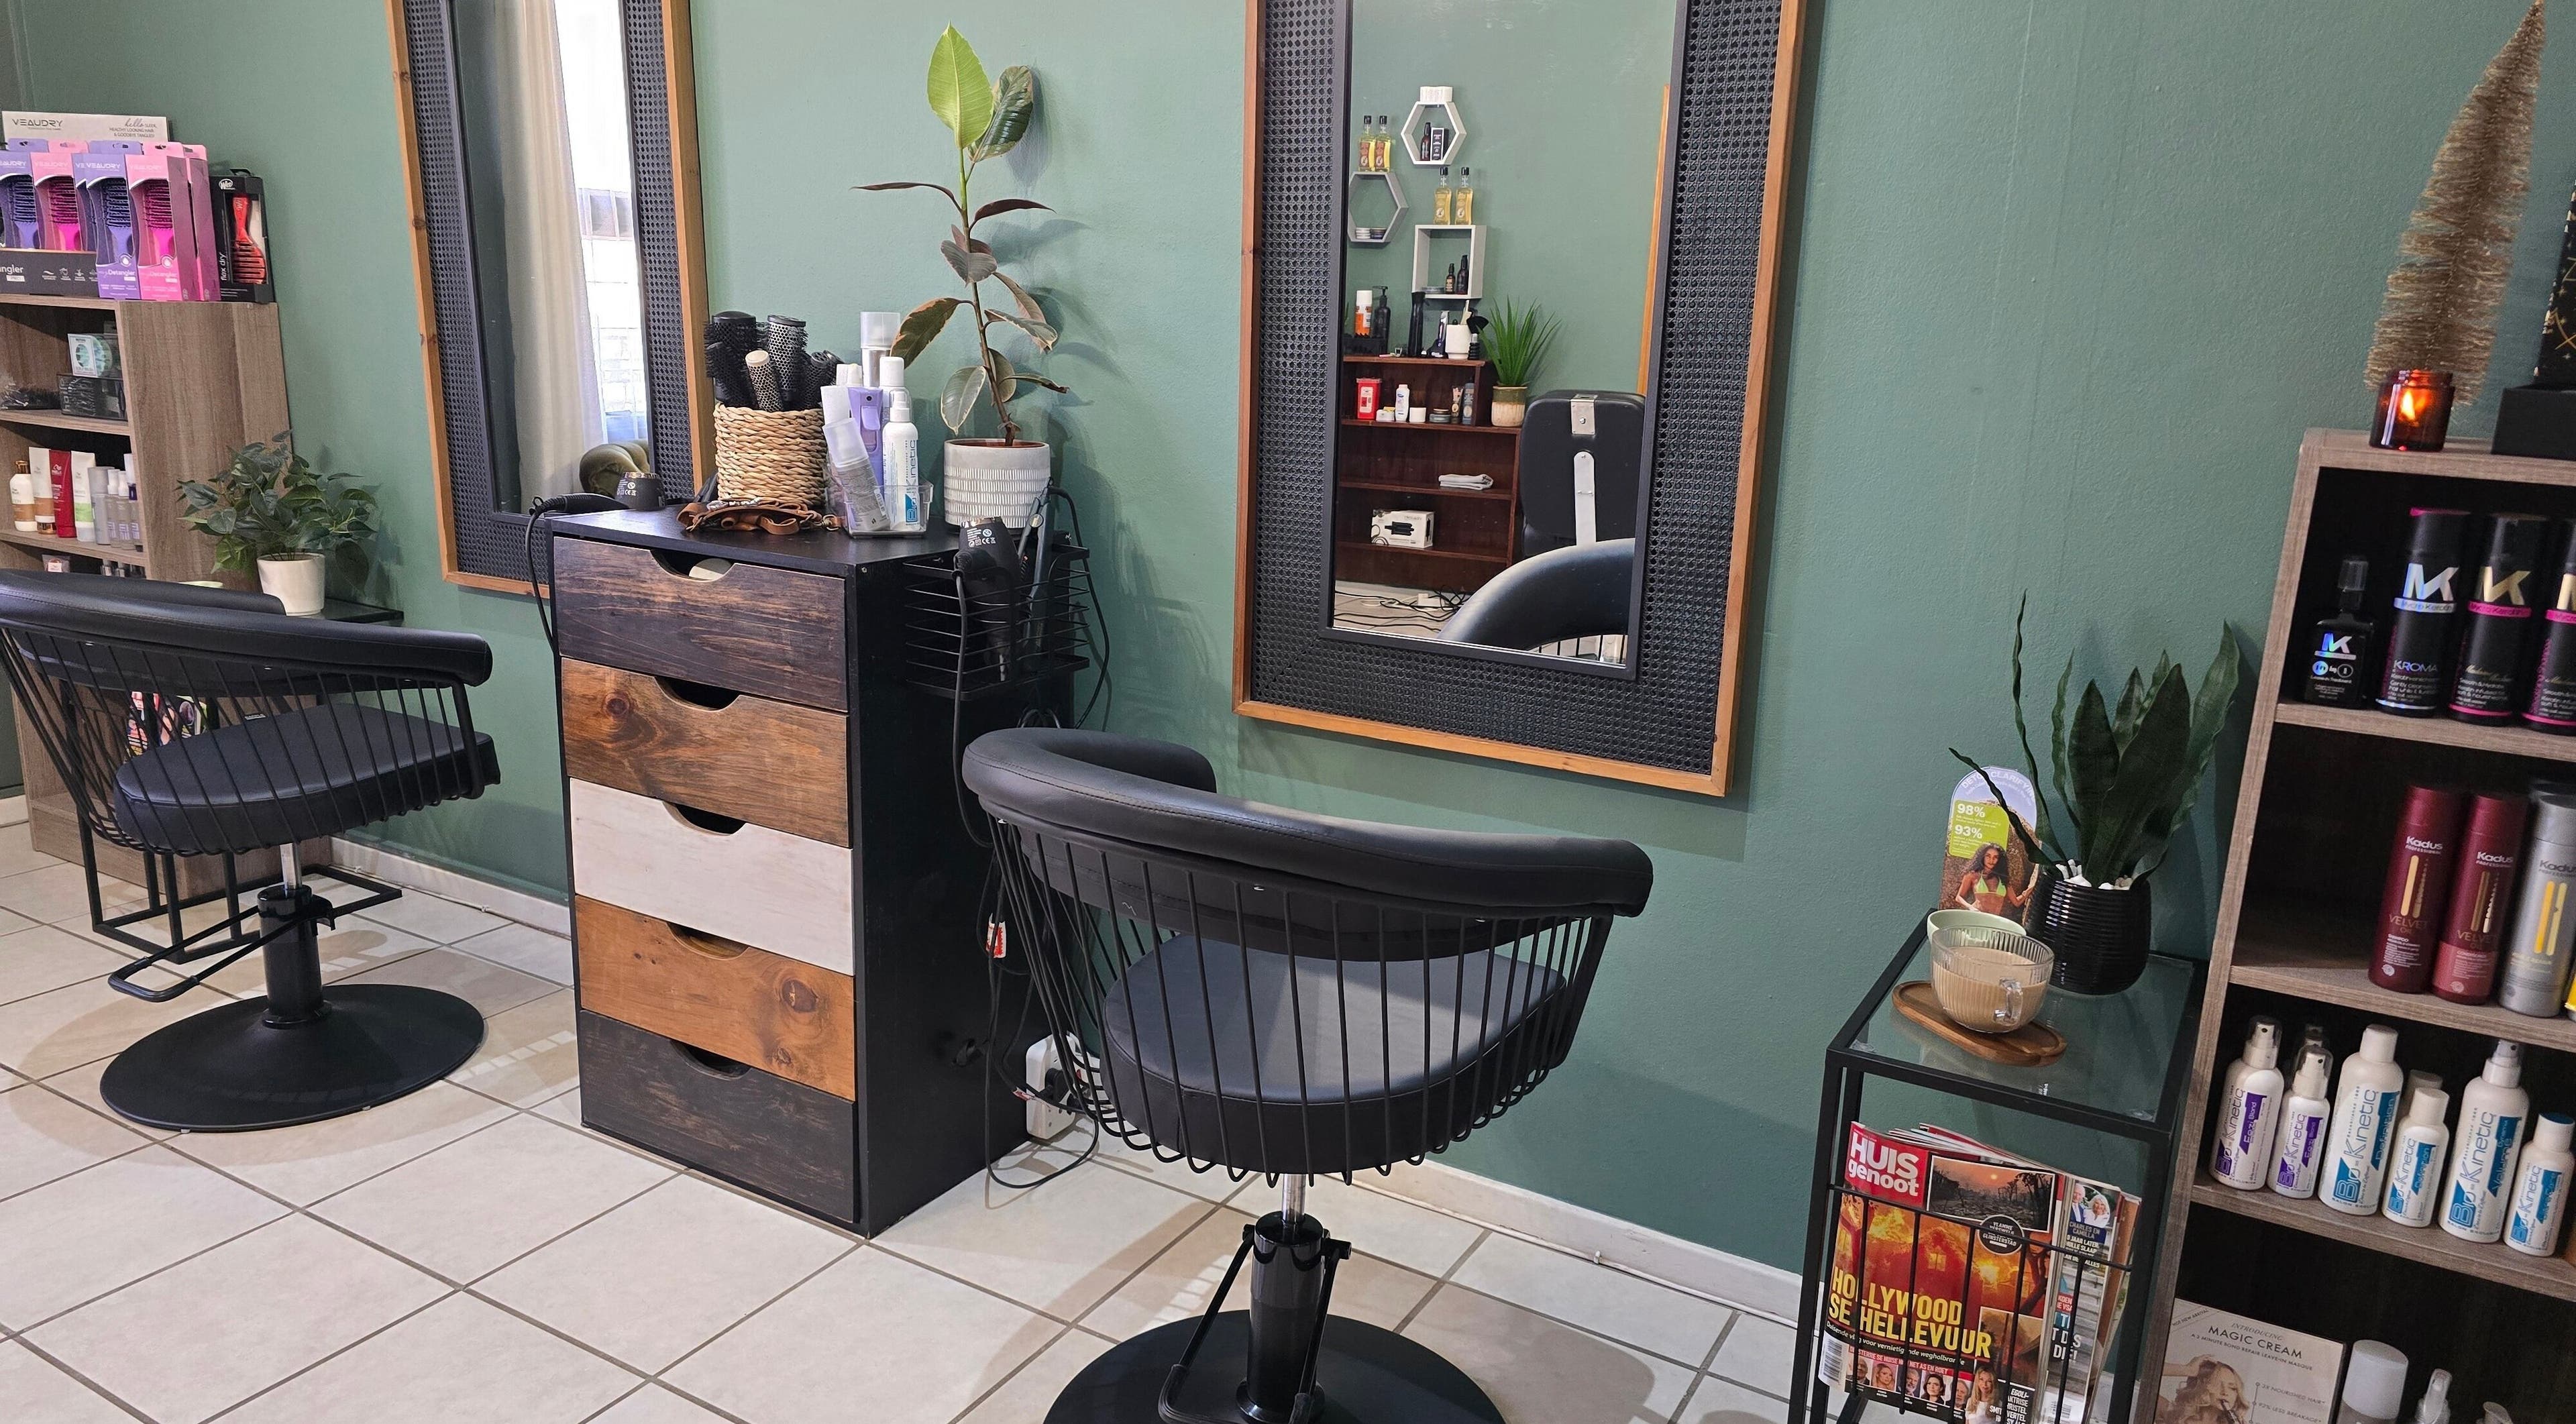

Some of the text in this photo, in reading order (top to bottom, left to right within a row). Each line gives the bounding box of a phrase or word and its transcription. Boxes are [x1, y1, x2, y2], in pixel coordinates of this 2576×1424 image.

[12, 119, 63, 127] VEAUDRY
[125, 118, 144, 127] hello
[0, 264, 23, 274] ngler
[2394, 660, 2437, 671] KROMA
[1957, 803, 1986, 818] 98%
[1955, 824, 1983, 839] 93%
[2406, 836, 2443, 851] Kadus
[2477, 851, 2514, 864] Kadus
[2540, 860, 2576, 873] Kadu
[2389, 914, 2428, 929] VELVET
[2375, 1098, 2395, 1160] Definition
[1851, 1132, 1919, 1179] HUIS
[2491, 1138, 2512, 1191] Volume
[1848, 1159, 1919, 1197] genoot
[2070, 1221, 2092, 1233] CHARLES
[1829, 1293, 1852, 1325] SE
[1827, 1321, 1849, 1337] Duisende
[2231, 1323, 2284, 1341] INTRODUCING
[2208, 1326, 2302, 1359] MAGIC CREAM
[2201, 1336, 2222, 1346] MINUTE
[2224, 1342, 2241, 1350] BOND
[2242, 1348, 2260, 1356] REPAIR
[2261, 1353, 2287, 1363] LEAVE-IN
[2288, 1361, 2313, 1371] MASQUE
